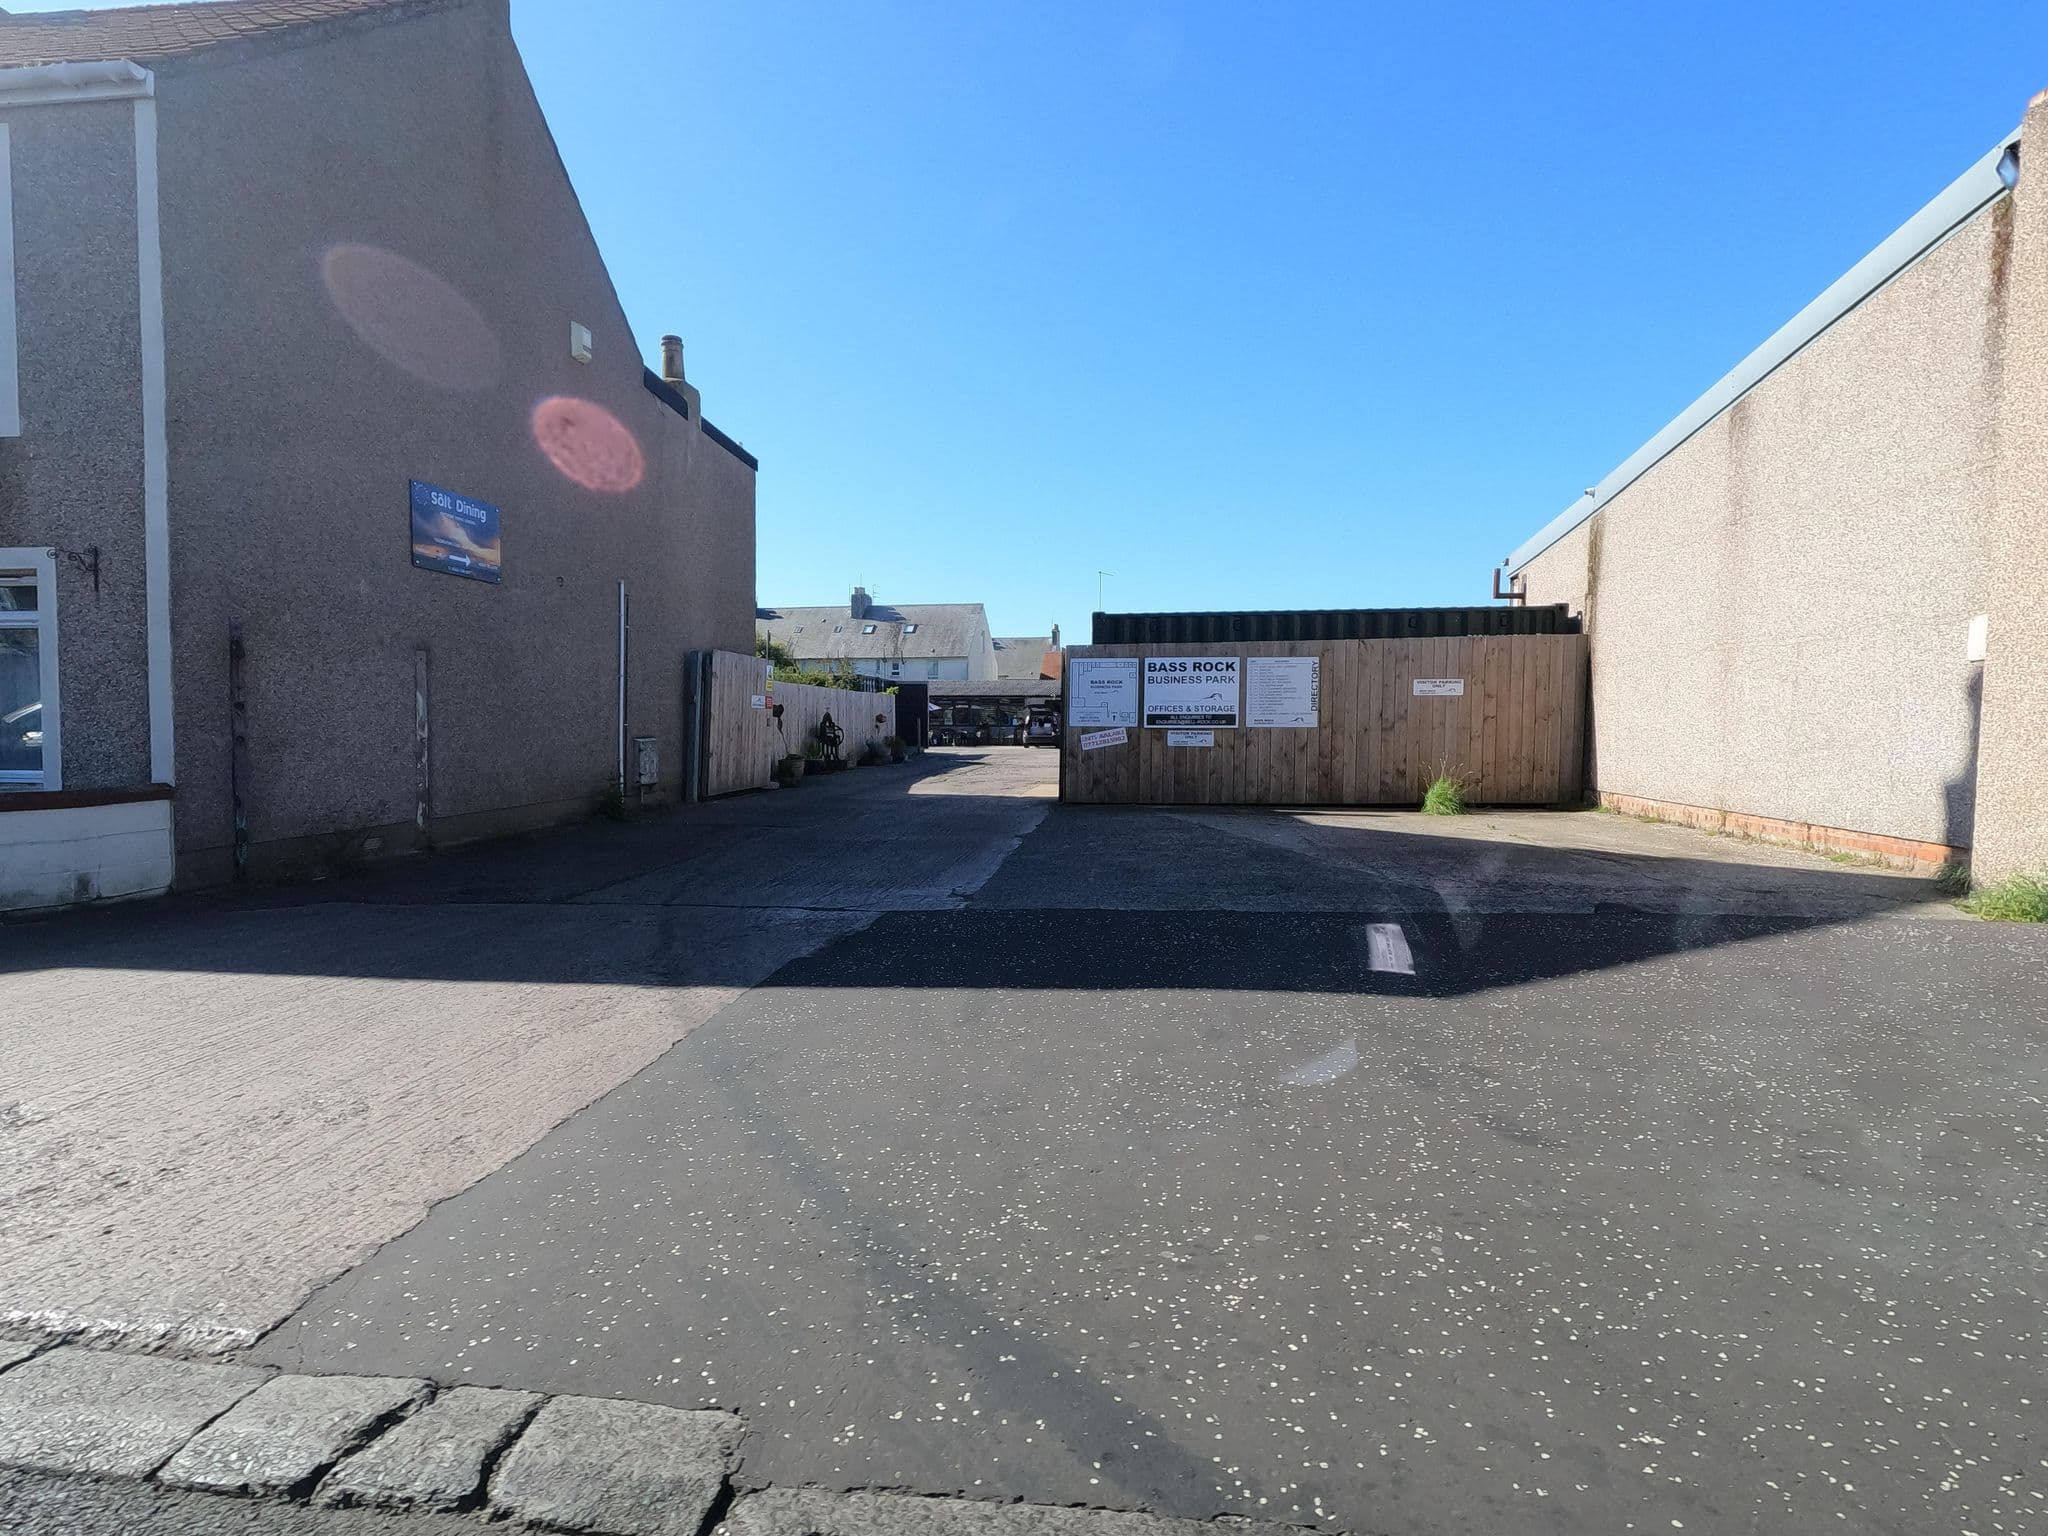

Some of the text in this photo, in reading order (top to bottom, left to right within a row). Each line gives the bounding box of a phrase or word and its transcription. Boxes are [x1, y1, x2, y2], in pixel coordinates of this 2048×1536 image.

[456, 499, 487, 523] Dining
[1147, 661, 1236, 672] BASS ROCK
[1147, 675, 1235, 685] BUSINESS PARK
[1310, 660, 1319, 712] DIRECTORY
